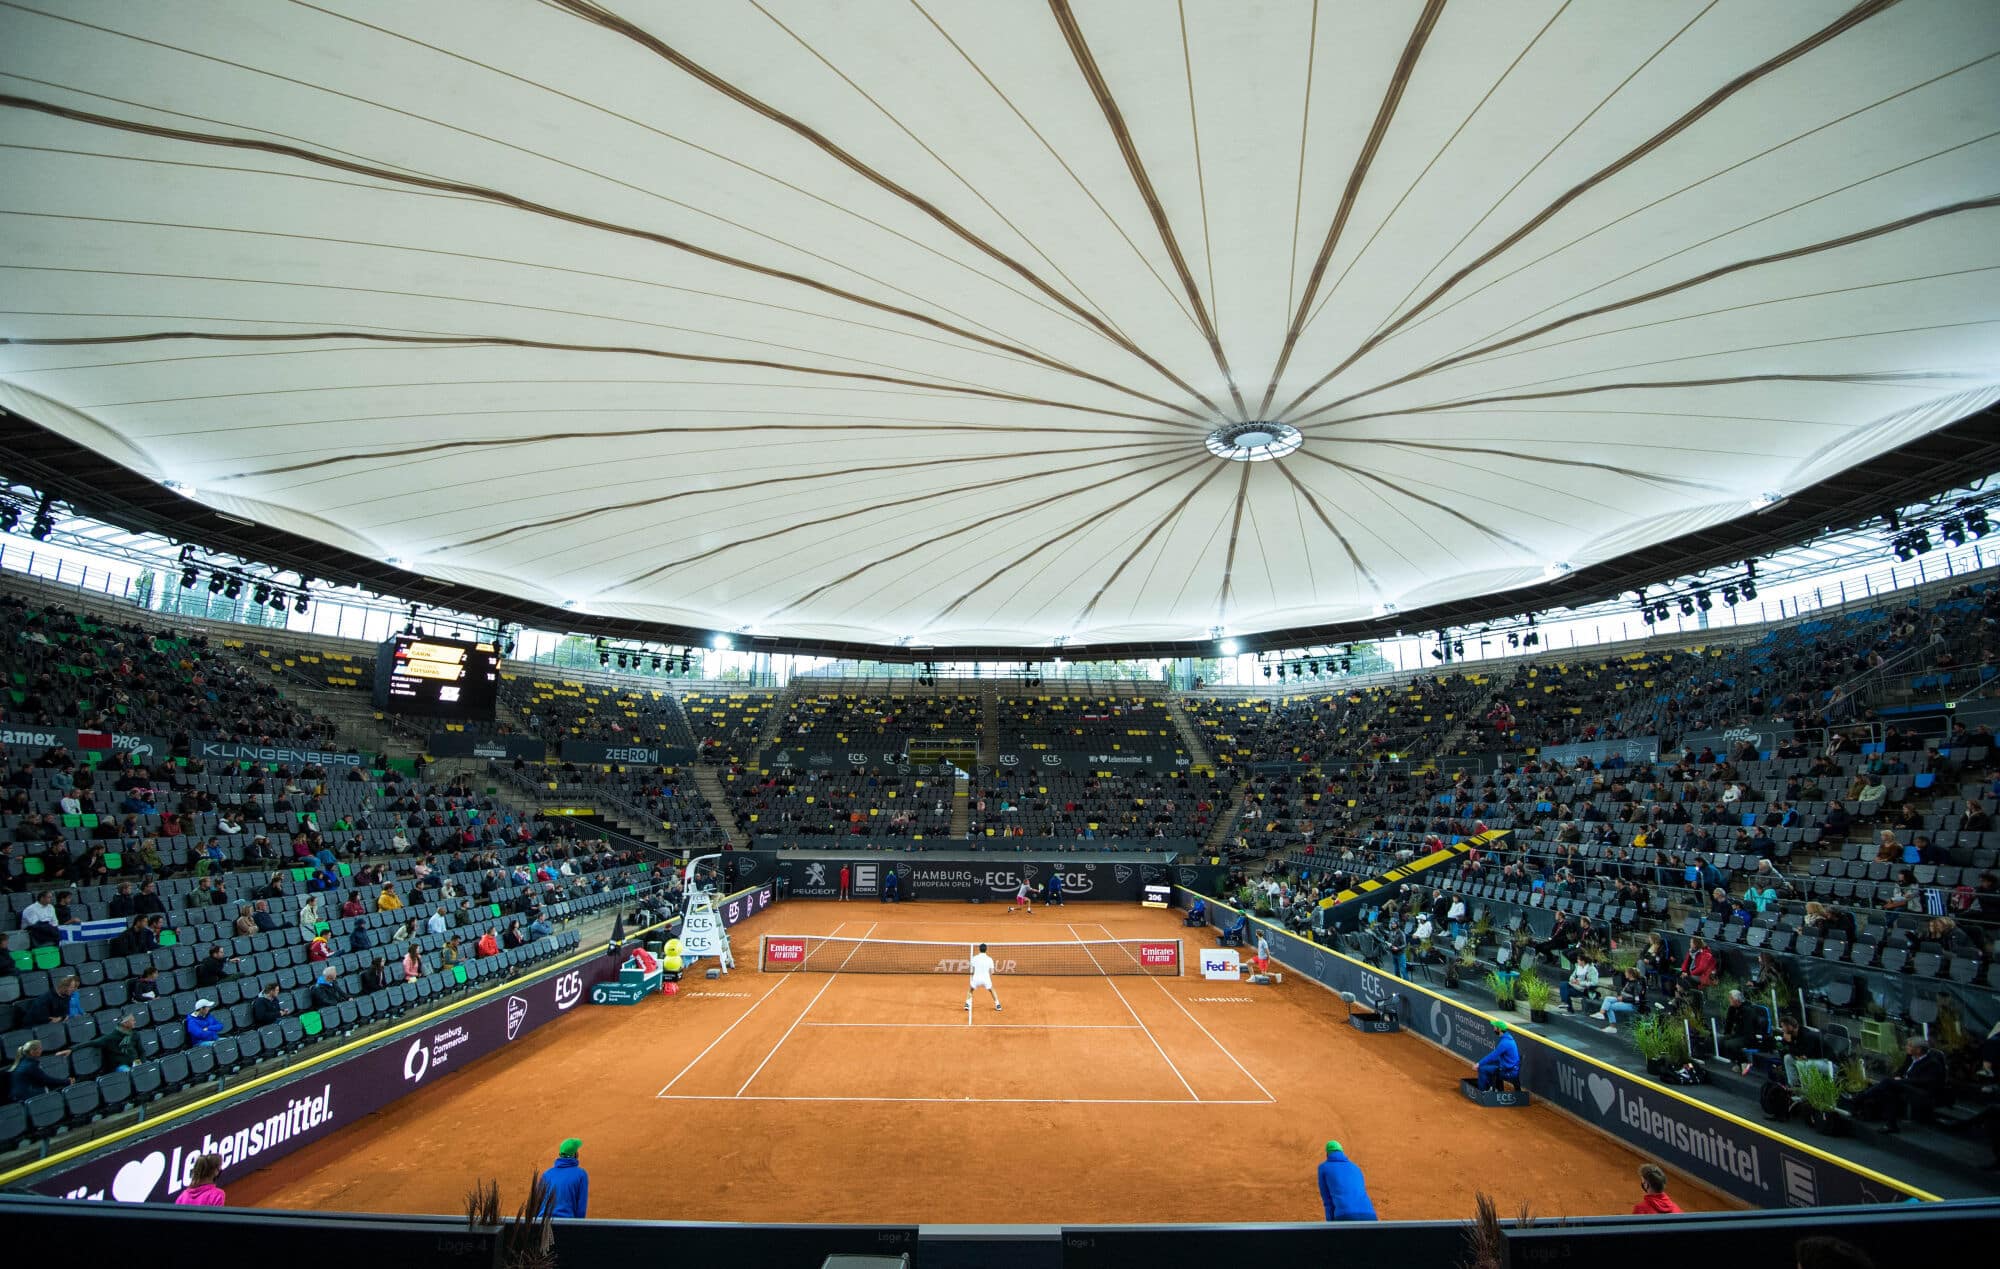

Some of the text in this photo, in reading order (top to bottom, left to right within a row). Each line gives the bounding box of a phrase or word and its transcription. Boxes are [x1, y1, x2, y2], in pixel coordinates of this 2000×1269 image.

[0, 730, 56, 747] amex
[1722, 727, 1750, 741] PRG
[112, 734, 141, 749] PRG
[202, 743, 360, 765] KLINGENBERG
[848, 753, 865, 762] ECE
[999, 754, 1017, 763] ECE
[1042, 754, 1059, 763] ECE
[913, 871, 972, 880] HAMBURG
[974, 876, 984, 886] by
[985, 872, 1016, 886] ECE
[687, 918, 709, 928] ECE
[685, 937, 707, 947] ECE
[770, 943, 803, 952] Emirates
[1142, 947, 1174, 956] Emirates
[934, 959, 970, 973] ATP
[1206, 960, 1238, 972] FedEx
[555, 970, 579, 1002] ECE
[1361, 971, 1381, 997] ECE
[1455, 1011, 1486, 1035] Hamburg
[434, 1026, 462, 1044] Hamburg
[1455, 1023, 1496, 1050] Commercial
[433, 1031, 469, 1056] Commercial
[1456, 1037, 1473, 1051] Bank
[432, 1051, 448, 1067] Bank
[1496, 1093, 1513, 1102] ECE
[1556, 1061, 1769, 1192] Wir Lebensmittel.
[878, 1231, 911, 1244] Loge 2
